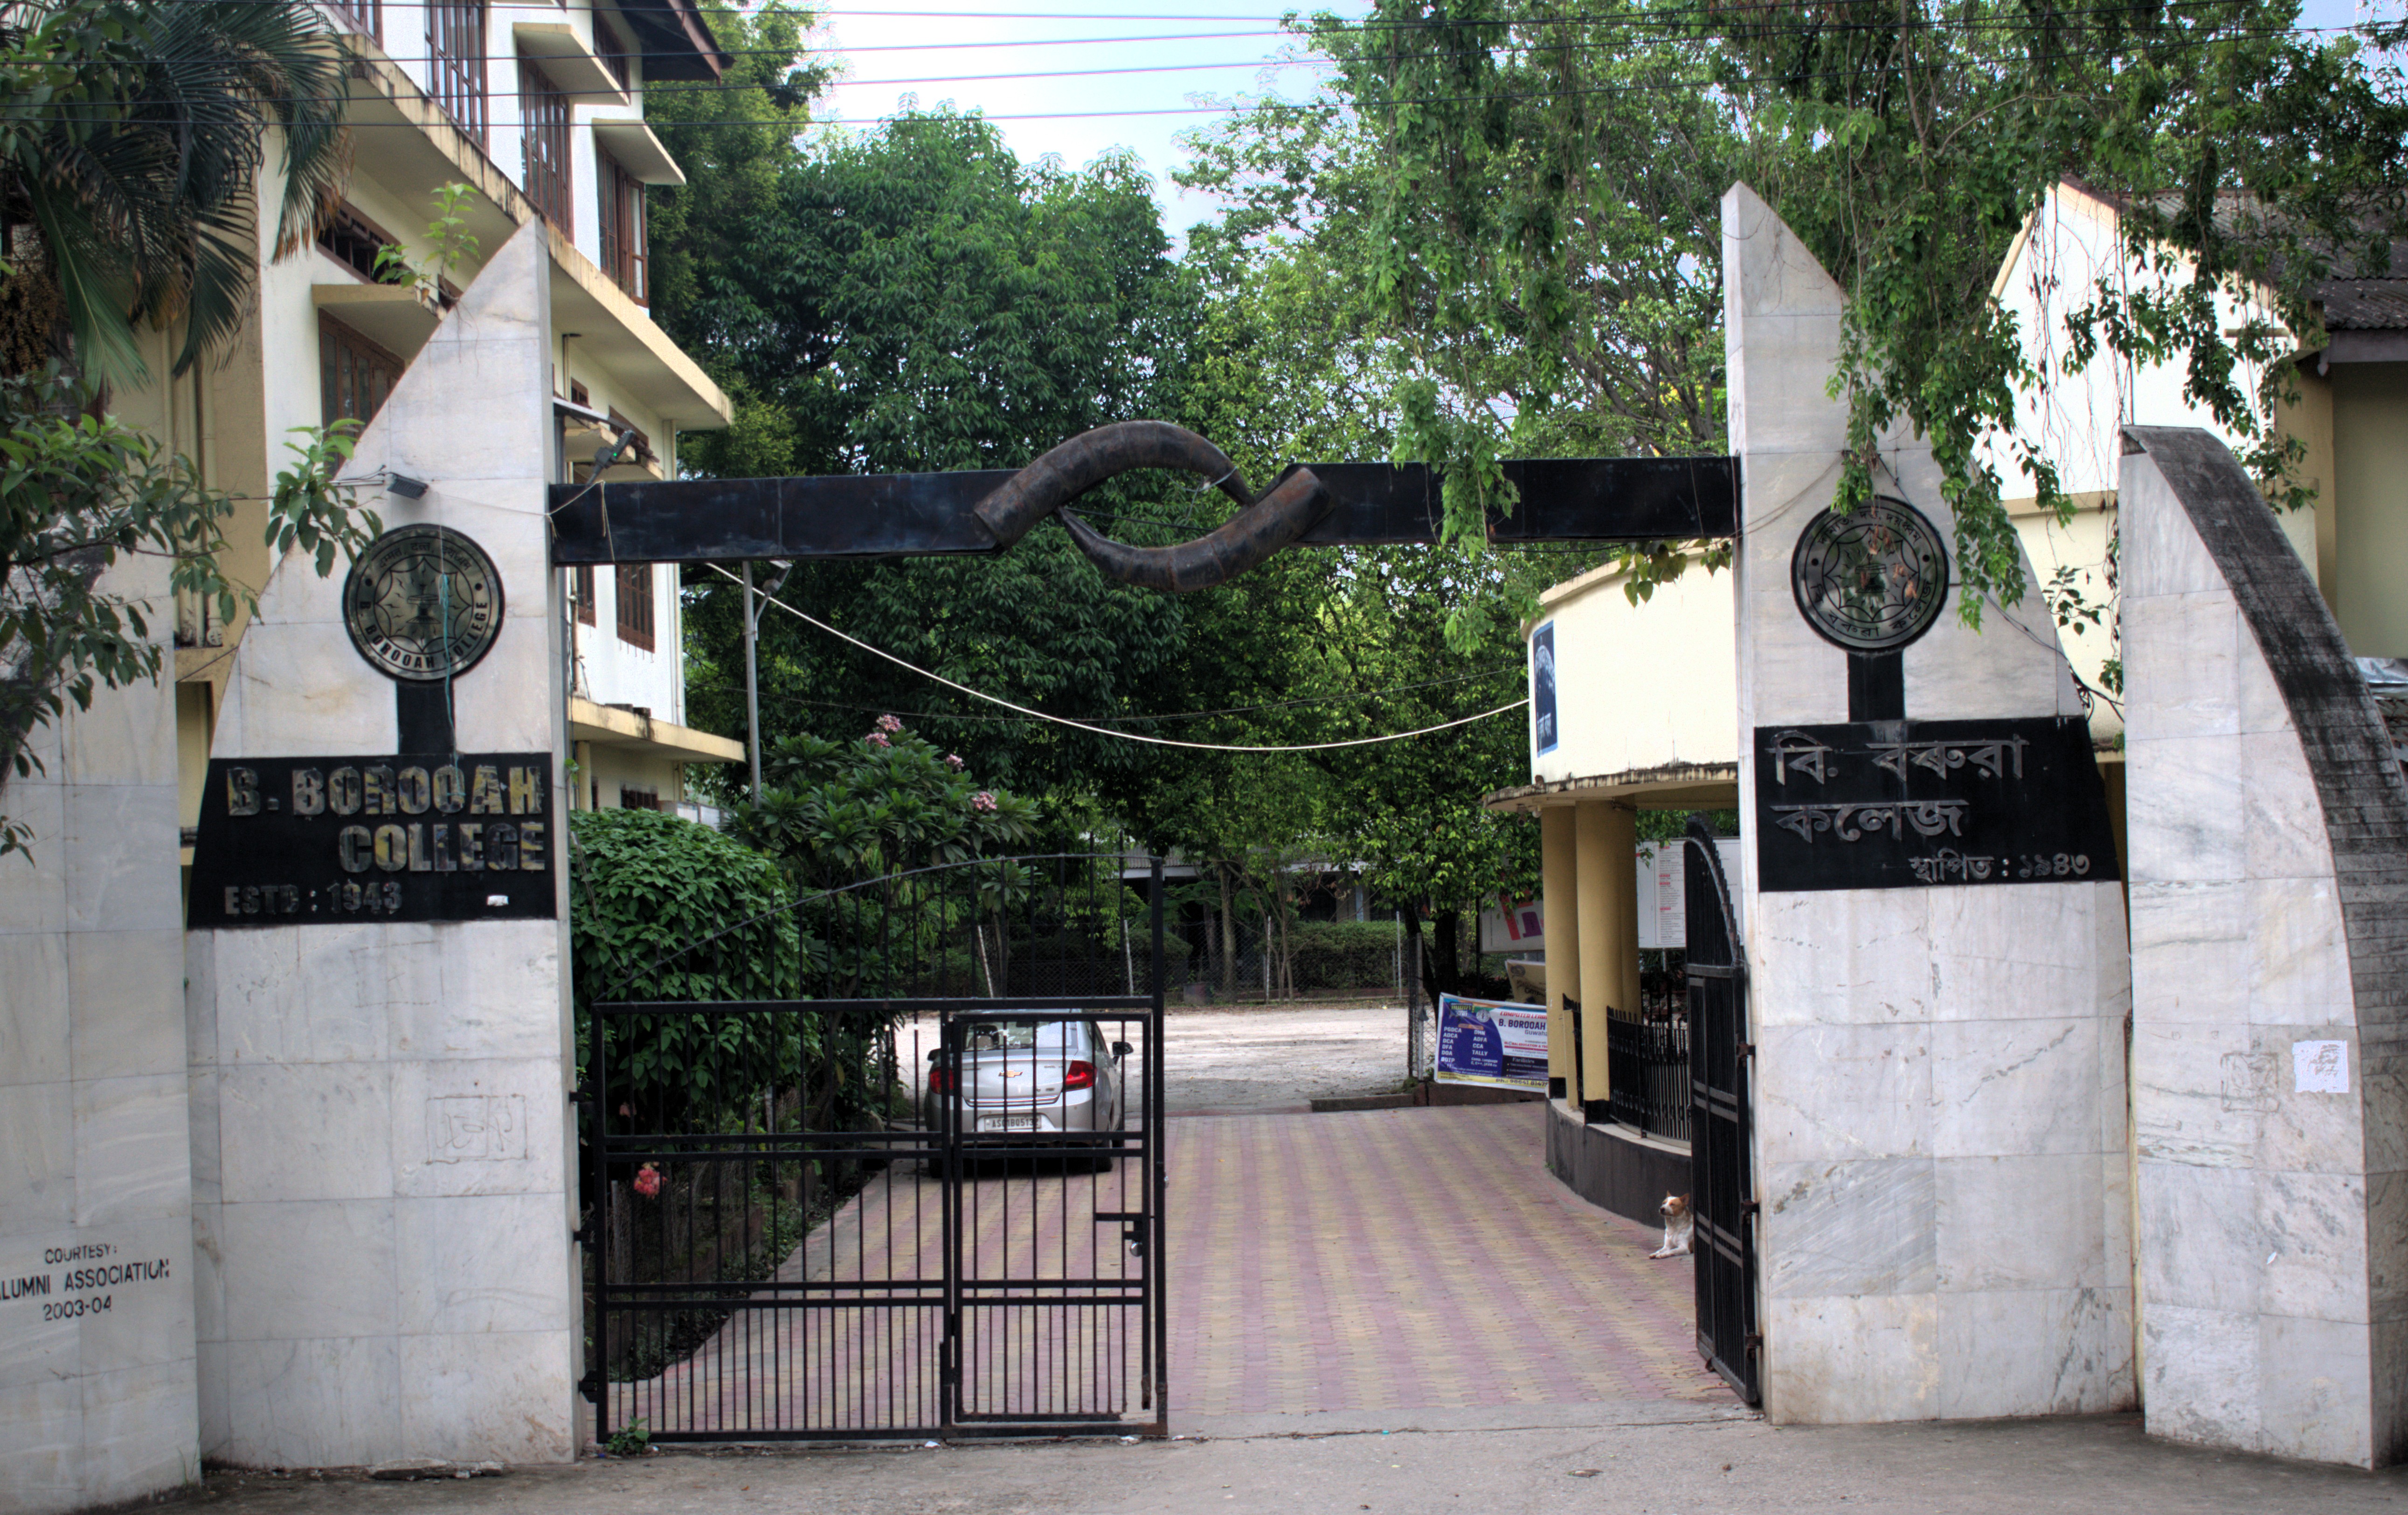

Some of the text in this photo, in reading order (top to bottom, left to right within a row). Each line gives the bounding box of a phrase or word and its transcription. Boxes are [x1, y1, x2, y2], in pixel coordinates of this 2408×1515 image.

[365, 624, 435, 668] BOROOAH
[443, 602, 488, 663] COLLEGE
[227, 765, 544, 816] B. BOROOAH
[1770, 800, 1970, 843] কলেজ
[339, 823, 545, 873] COLLEGE
[326, 880, 403, 915] 1943
[1499, 1018, 1546, 1030] B. BOROOAH
[64, 1259, 170, 1292] ASSOCIATION
[43, 1294, 112, 1321] 2003-04
